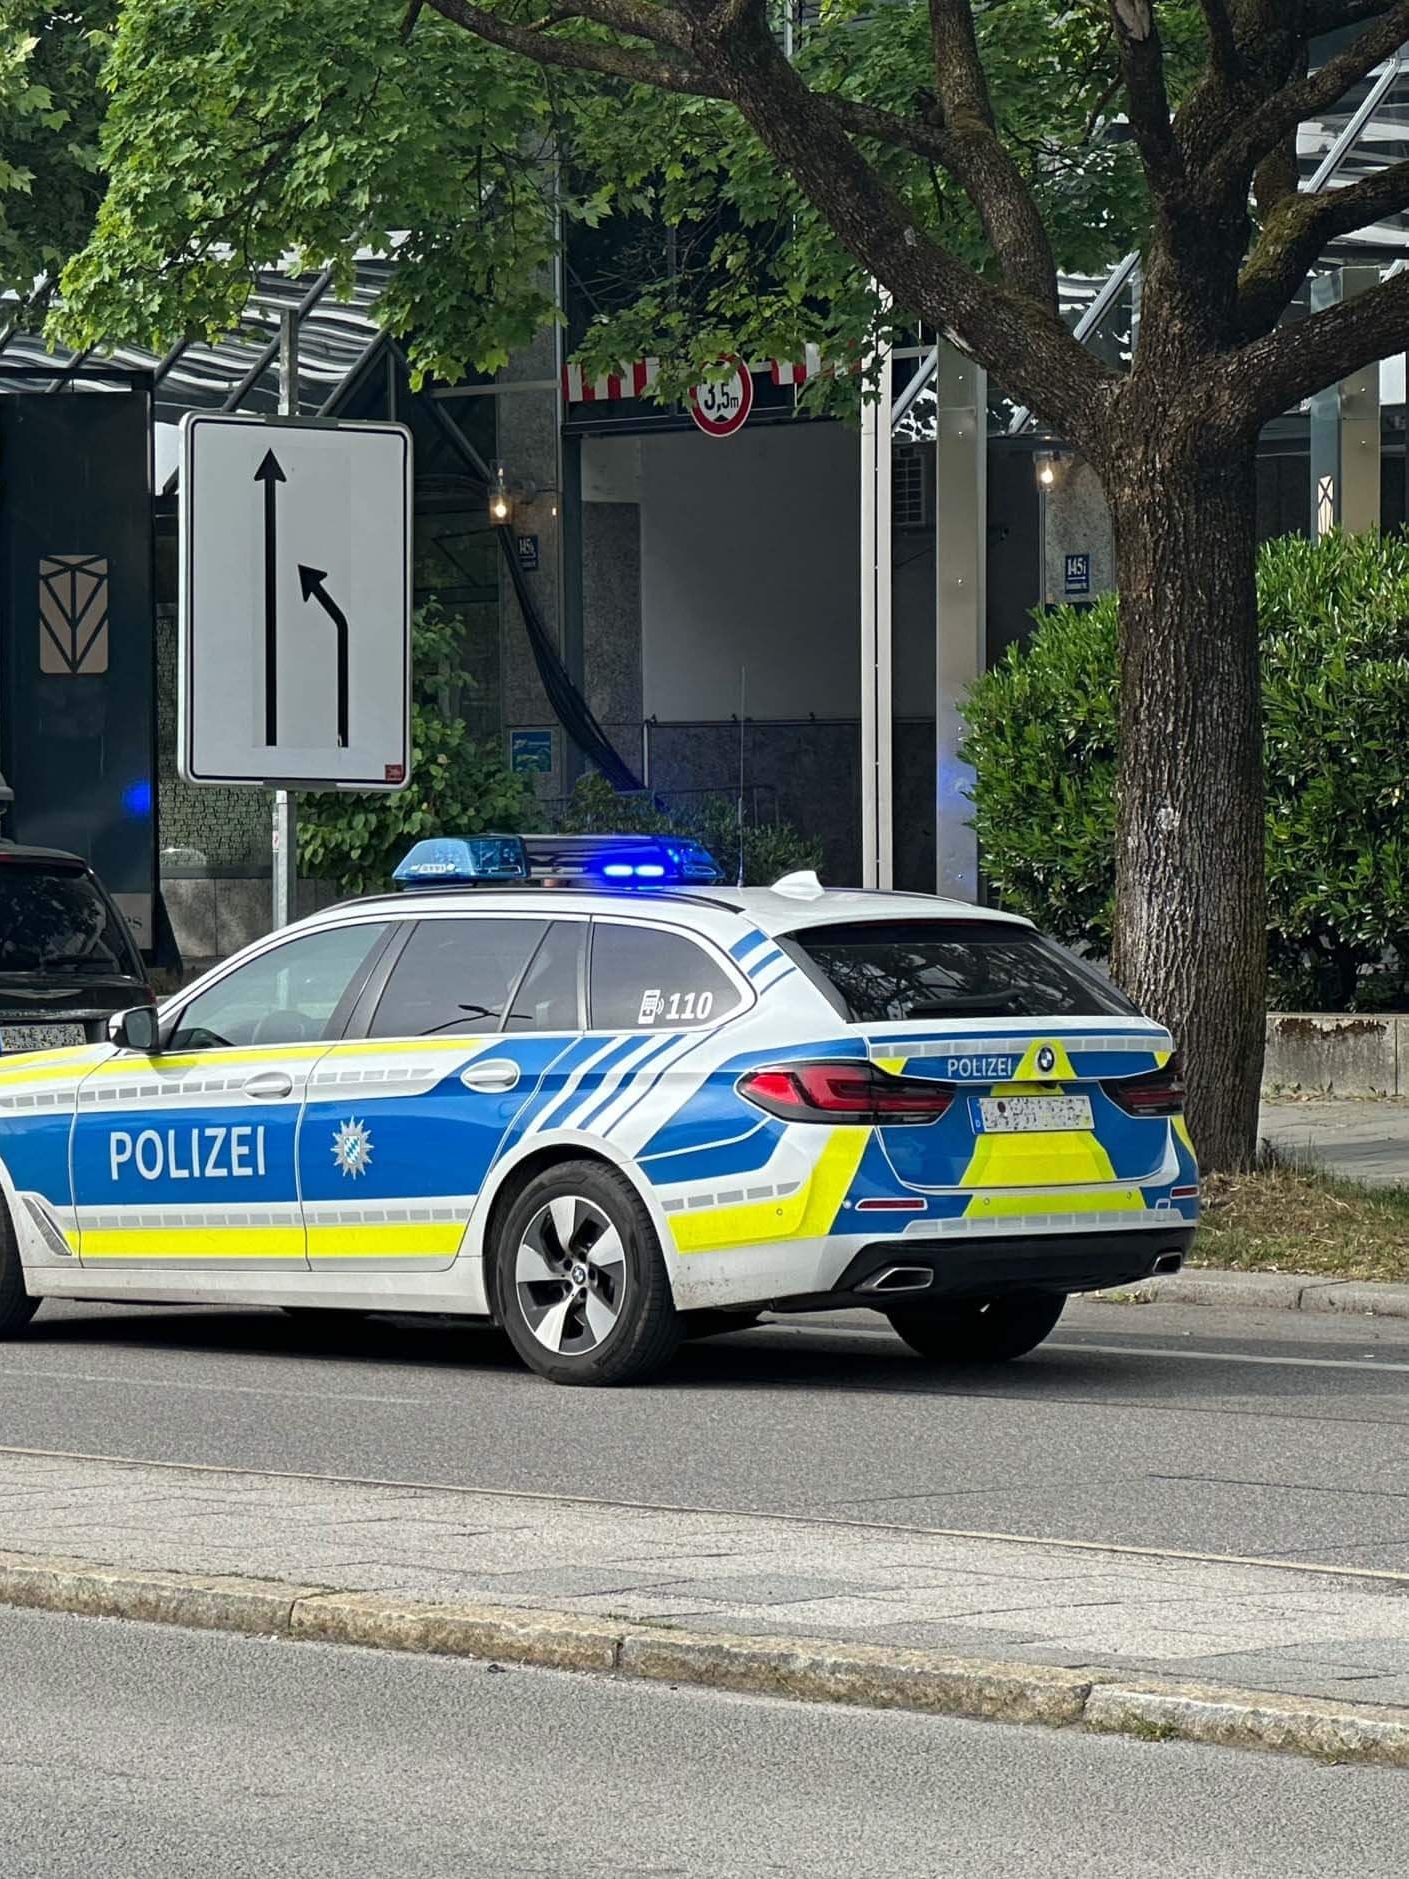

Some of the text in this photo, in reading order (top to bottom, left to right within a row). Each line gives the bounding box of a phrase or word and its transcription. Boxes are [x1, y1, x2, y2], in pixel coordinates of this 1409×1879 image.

[665, 991, 713, 1020] 110
[947, 1057, 1012, 1077] POLIZEI
[110, 1125, 266, 1181] POLIZEI
